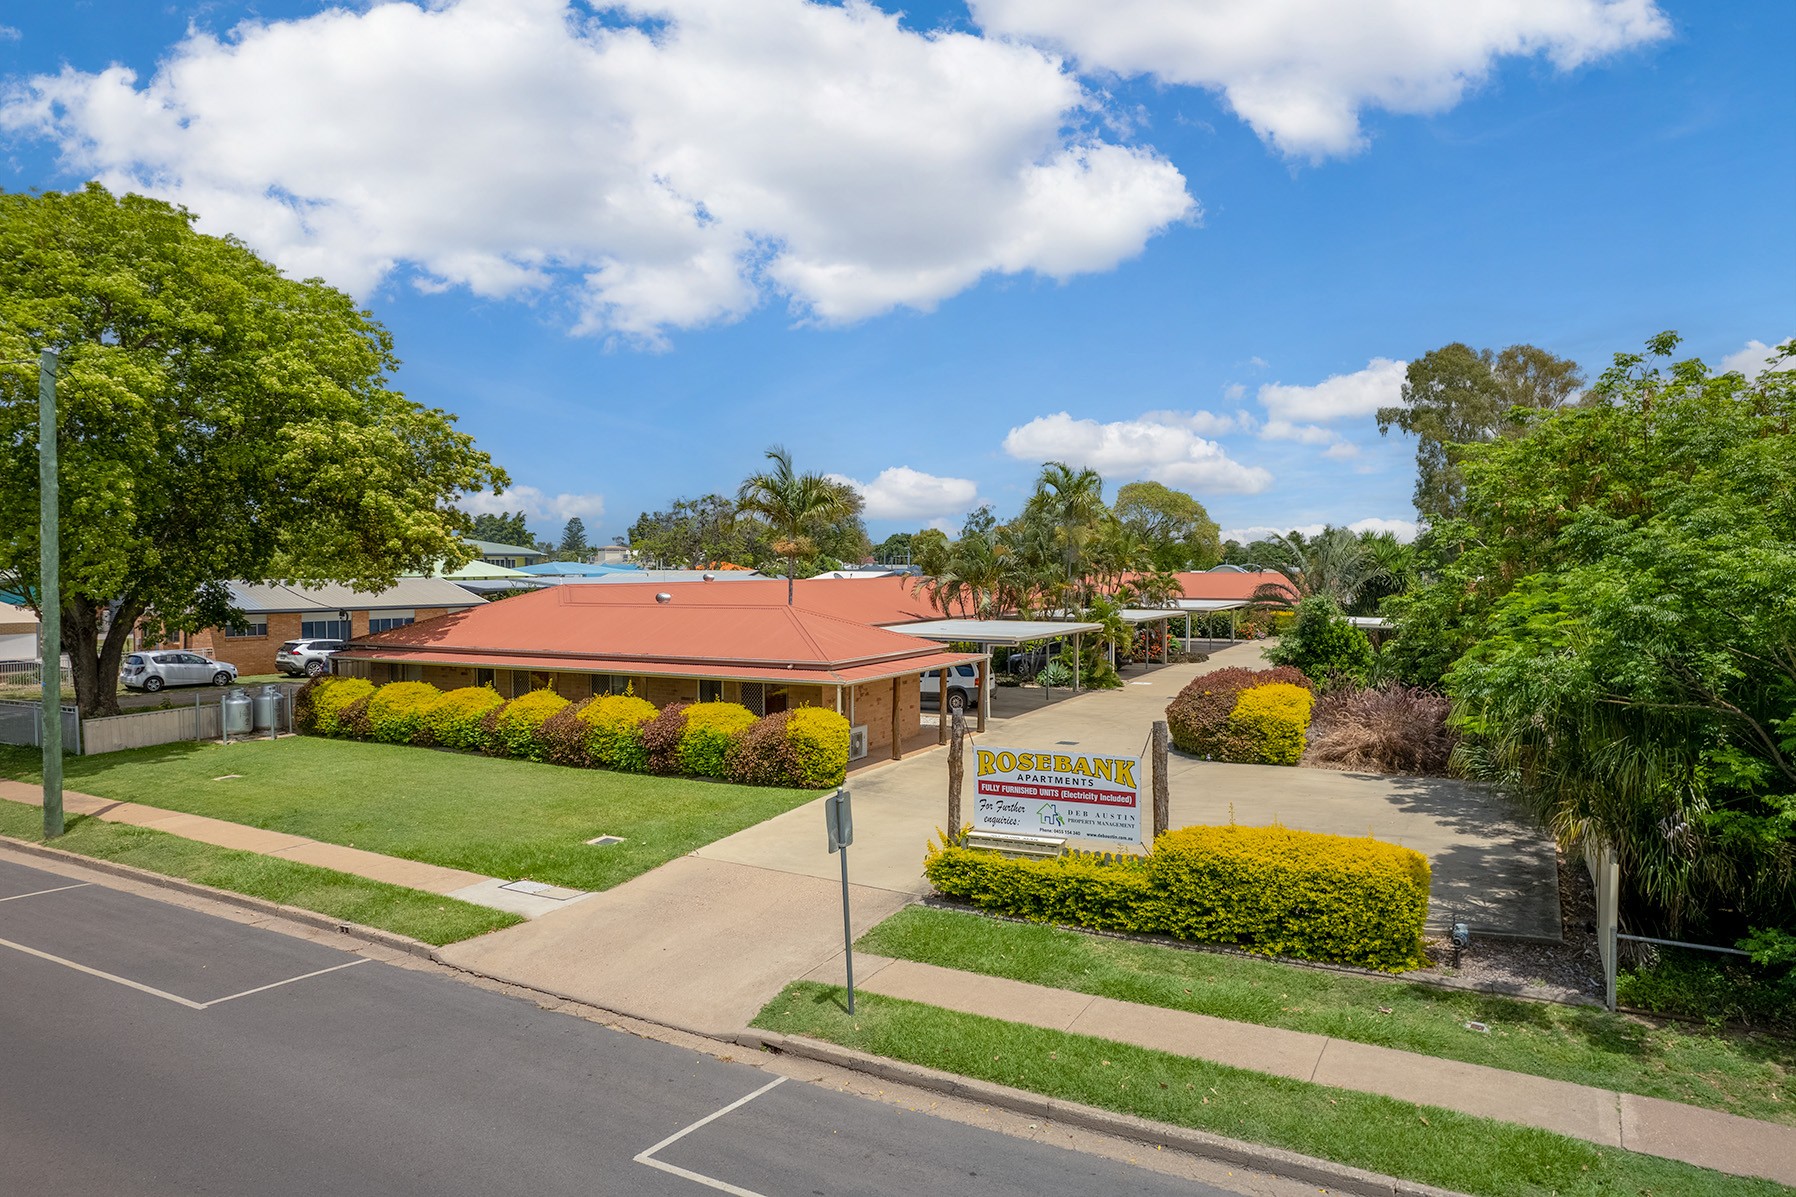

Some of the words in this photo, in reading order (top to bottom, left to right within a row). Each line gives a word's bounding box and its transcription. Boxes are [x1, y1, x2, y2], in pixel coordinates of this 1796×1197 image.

[977, 750, 1137, 789] ROSEBANK
[1017, 773, 1094, 787] APARTMENTS
[981, 783, 1000, 793] FULLY
[1001, 786, 1038, 797] FURNISHED
[1039, 788, 1059, 798] UNITS
[1060, 791, 1099, 802] (Electricity
[1099, 794, 1133, 805] Included)
[979, 798, 994, 812] For
[996, 800, 1026, 813] Further
[983, 815, 1021, 828] enquiries:
[1067, 809, 1089, 817] DEB
[1095, 812, 1136, 821] AUSTIN
[1096, 820, 1135, 829] MANAGEMENT
